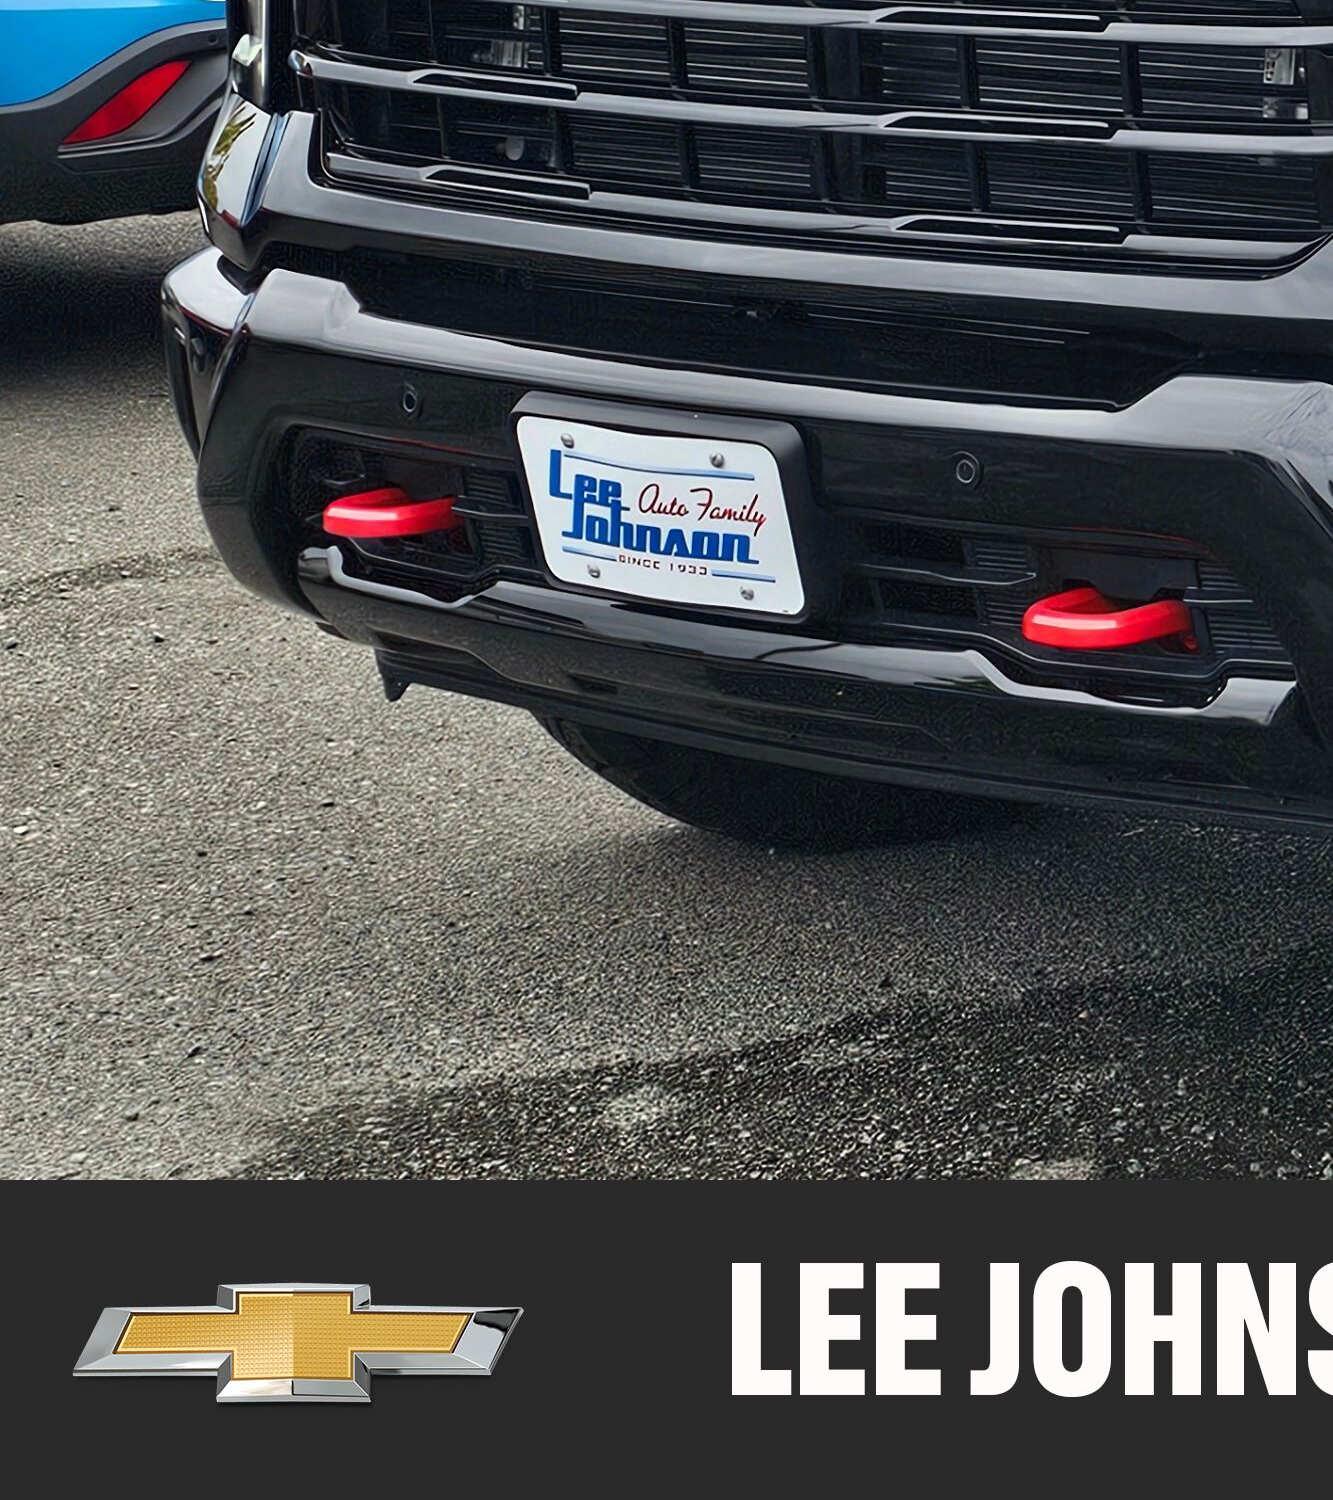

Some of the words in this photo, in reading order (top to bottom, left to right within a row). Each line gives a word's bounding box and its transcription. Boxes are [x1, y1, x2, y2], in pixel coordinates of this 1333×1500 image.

[549, 448, 631, 511] Lee
[561, 499, 760, 565] Johnson
[638, 483, 690, 518] Auto
[690, 487, 767, 536] Family
[618, 553, 661, 571] SINCE
[669, 561, 708, 576] 1933
